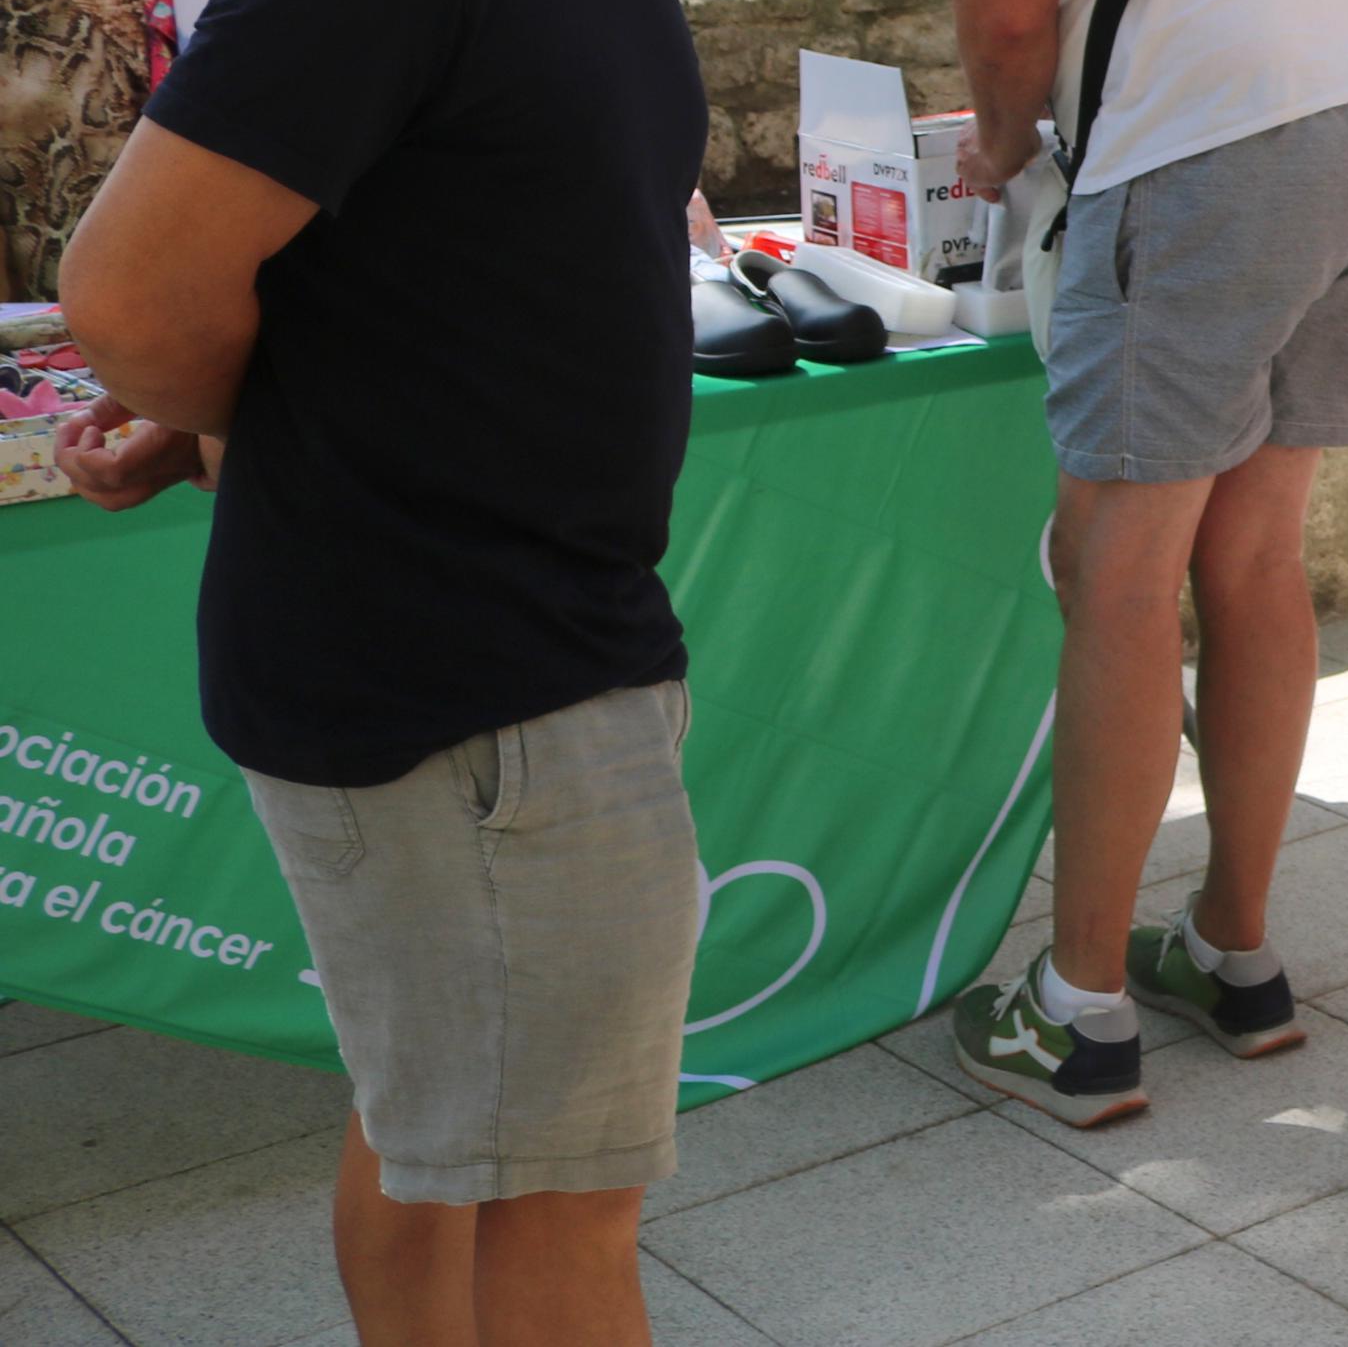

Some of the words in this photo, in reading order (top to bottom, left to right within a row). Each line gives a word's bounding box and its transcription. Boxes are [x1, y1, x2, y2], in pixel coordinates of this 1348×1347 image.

[803, 157, 847, 185] redbell
[0, 724, 202, 819] ociación
[0, 795, 138, 868] añola
[42, 880, 102, 924] el
[101, 898, 275, 971] cáncer
